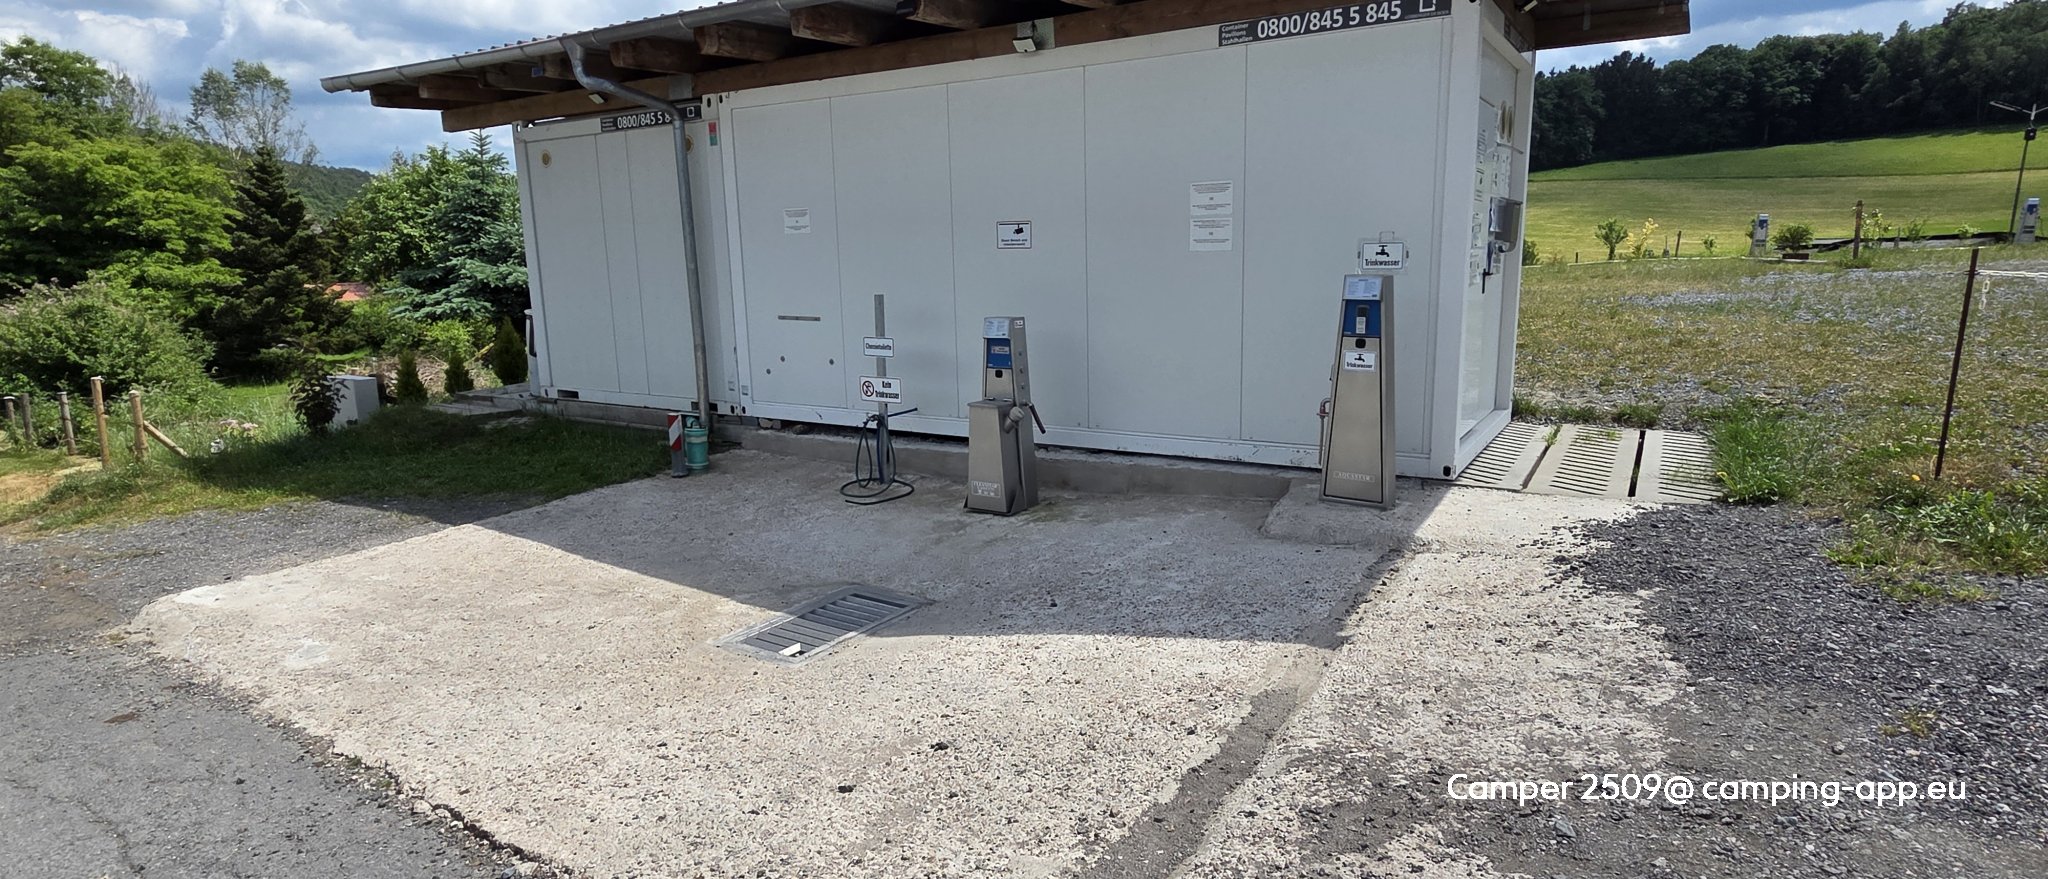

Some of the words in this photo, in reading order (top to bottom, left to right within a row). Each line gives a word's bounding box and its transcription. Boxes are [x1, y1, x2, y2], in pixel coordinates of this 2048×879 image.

[1257, 8, 1343, 39] 0800/845
[1349, 6, 1361, 26] 5
[1366, 0, 1402, 23] 845
[1221, 23, 1249, 32] Container
[1221, 36, 1253, 45] Stahlhallen
[617, 112, 656, 129] 0800/845
[657, 111, 663, 124] 5
[1364, 258, 1400, 266] Trinkwasser
[1346, 361, 1373, 369] Trinkwasser
[874, 390, 900, 399] Trinkwasser
